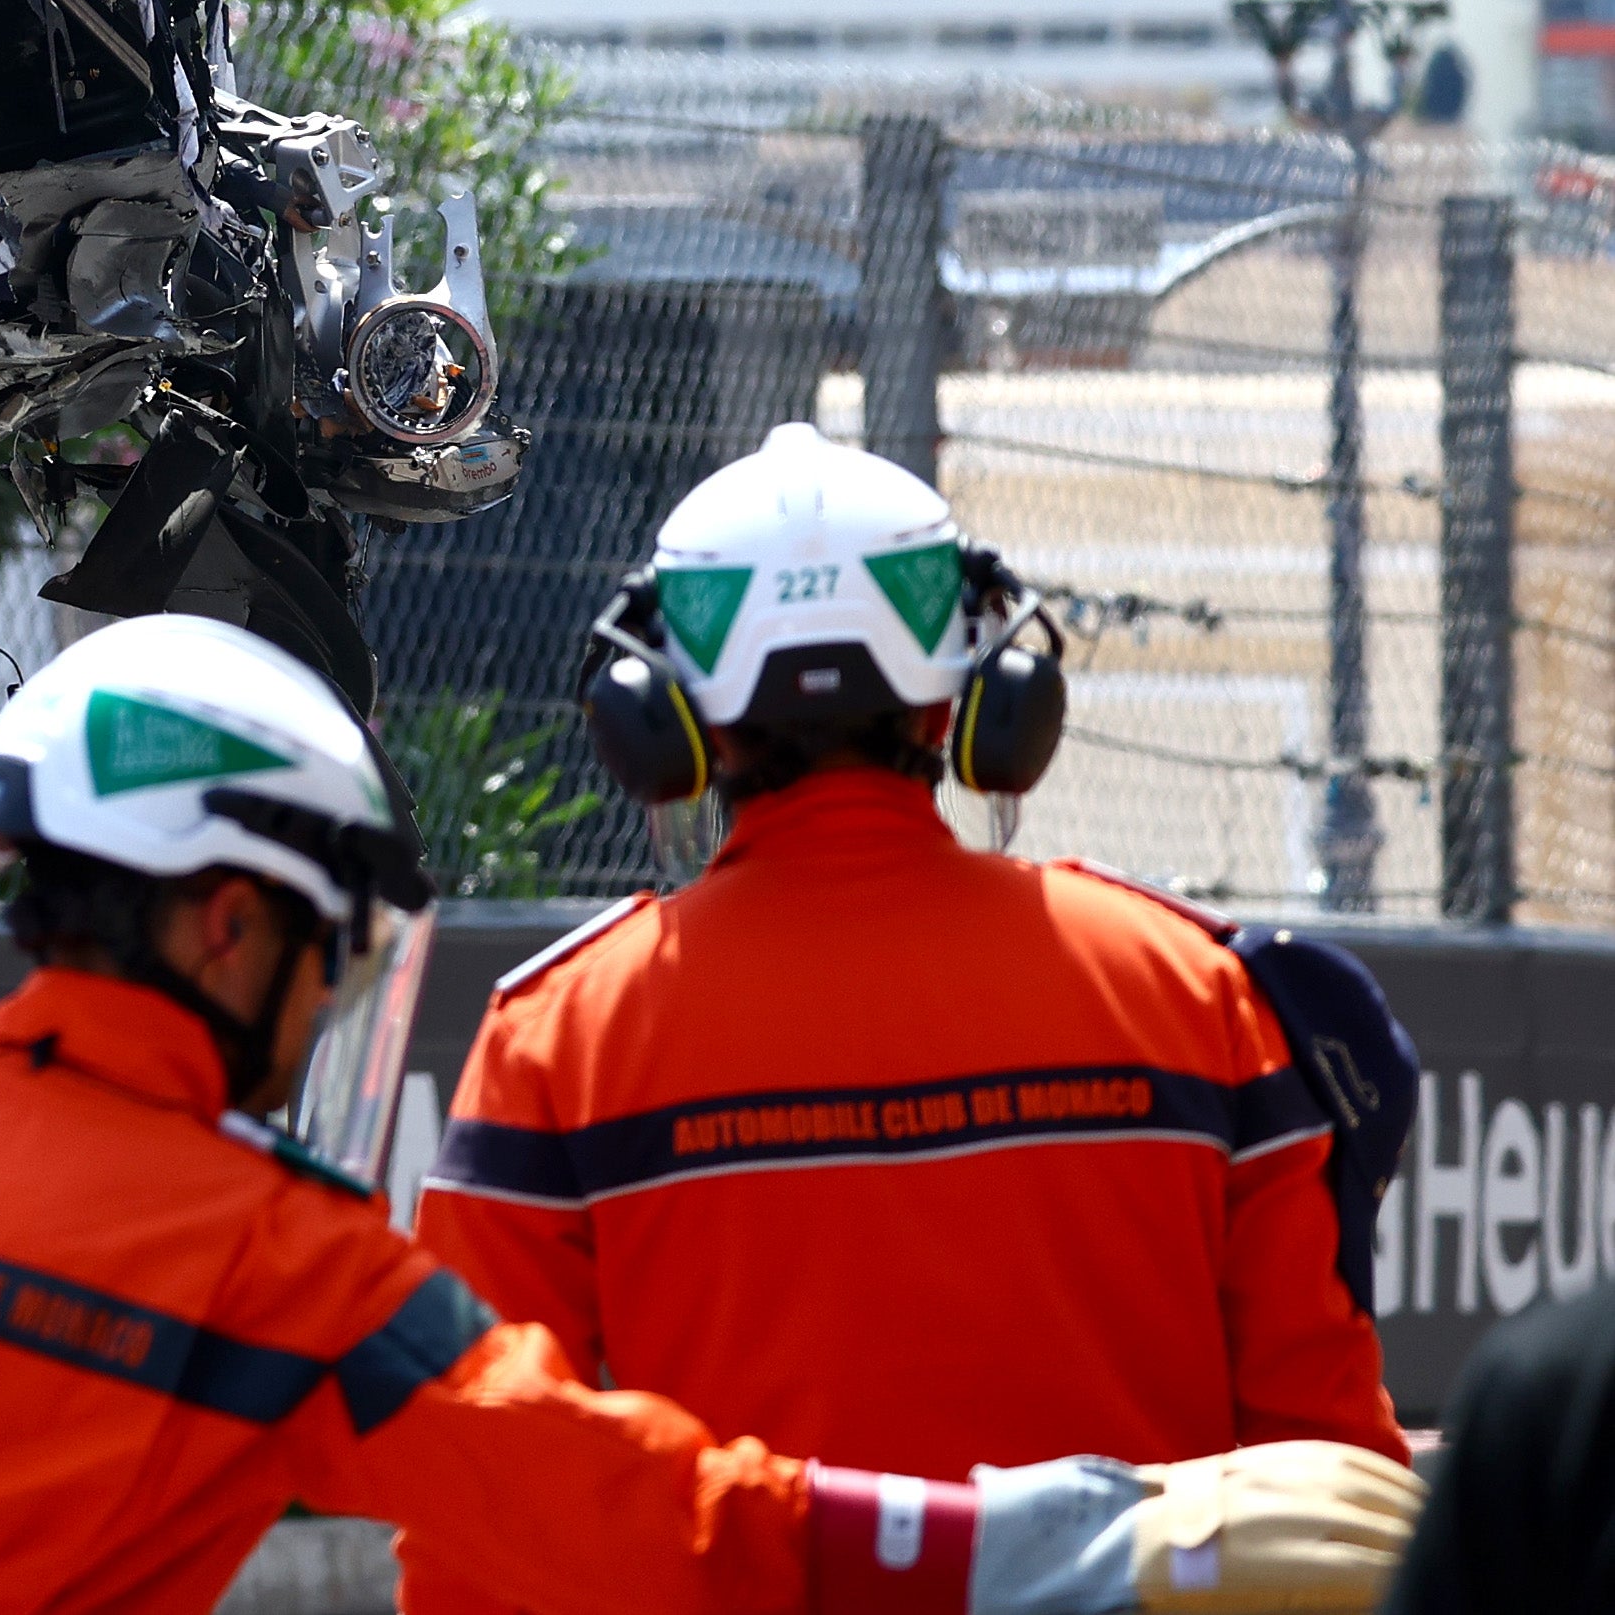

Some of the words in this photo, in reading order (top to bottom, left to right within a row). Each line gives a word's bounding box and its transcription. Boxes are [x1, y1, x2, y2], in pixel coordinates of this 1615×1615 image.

[776, 564, 840, 604] 227
[673, 1099, 878, 1157] AUTOMOBILE
[880, 1092, 968, 1140] CLUB
[971, 1086, 1015, 1126] DE
[1017, 1077, 1153, 1122] MONACO
